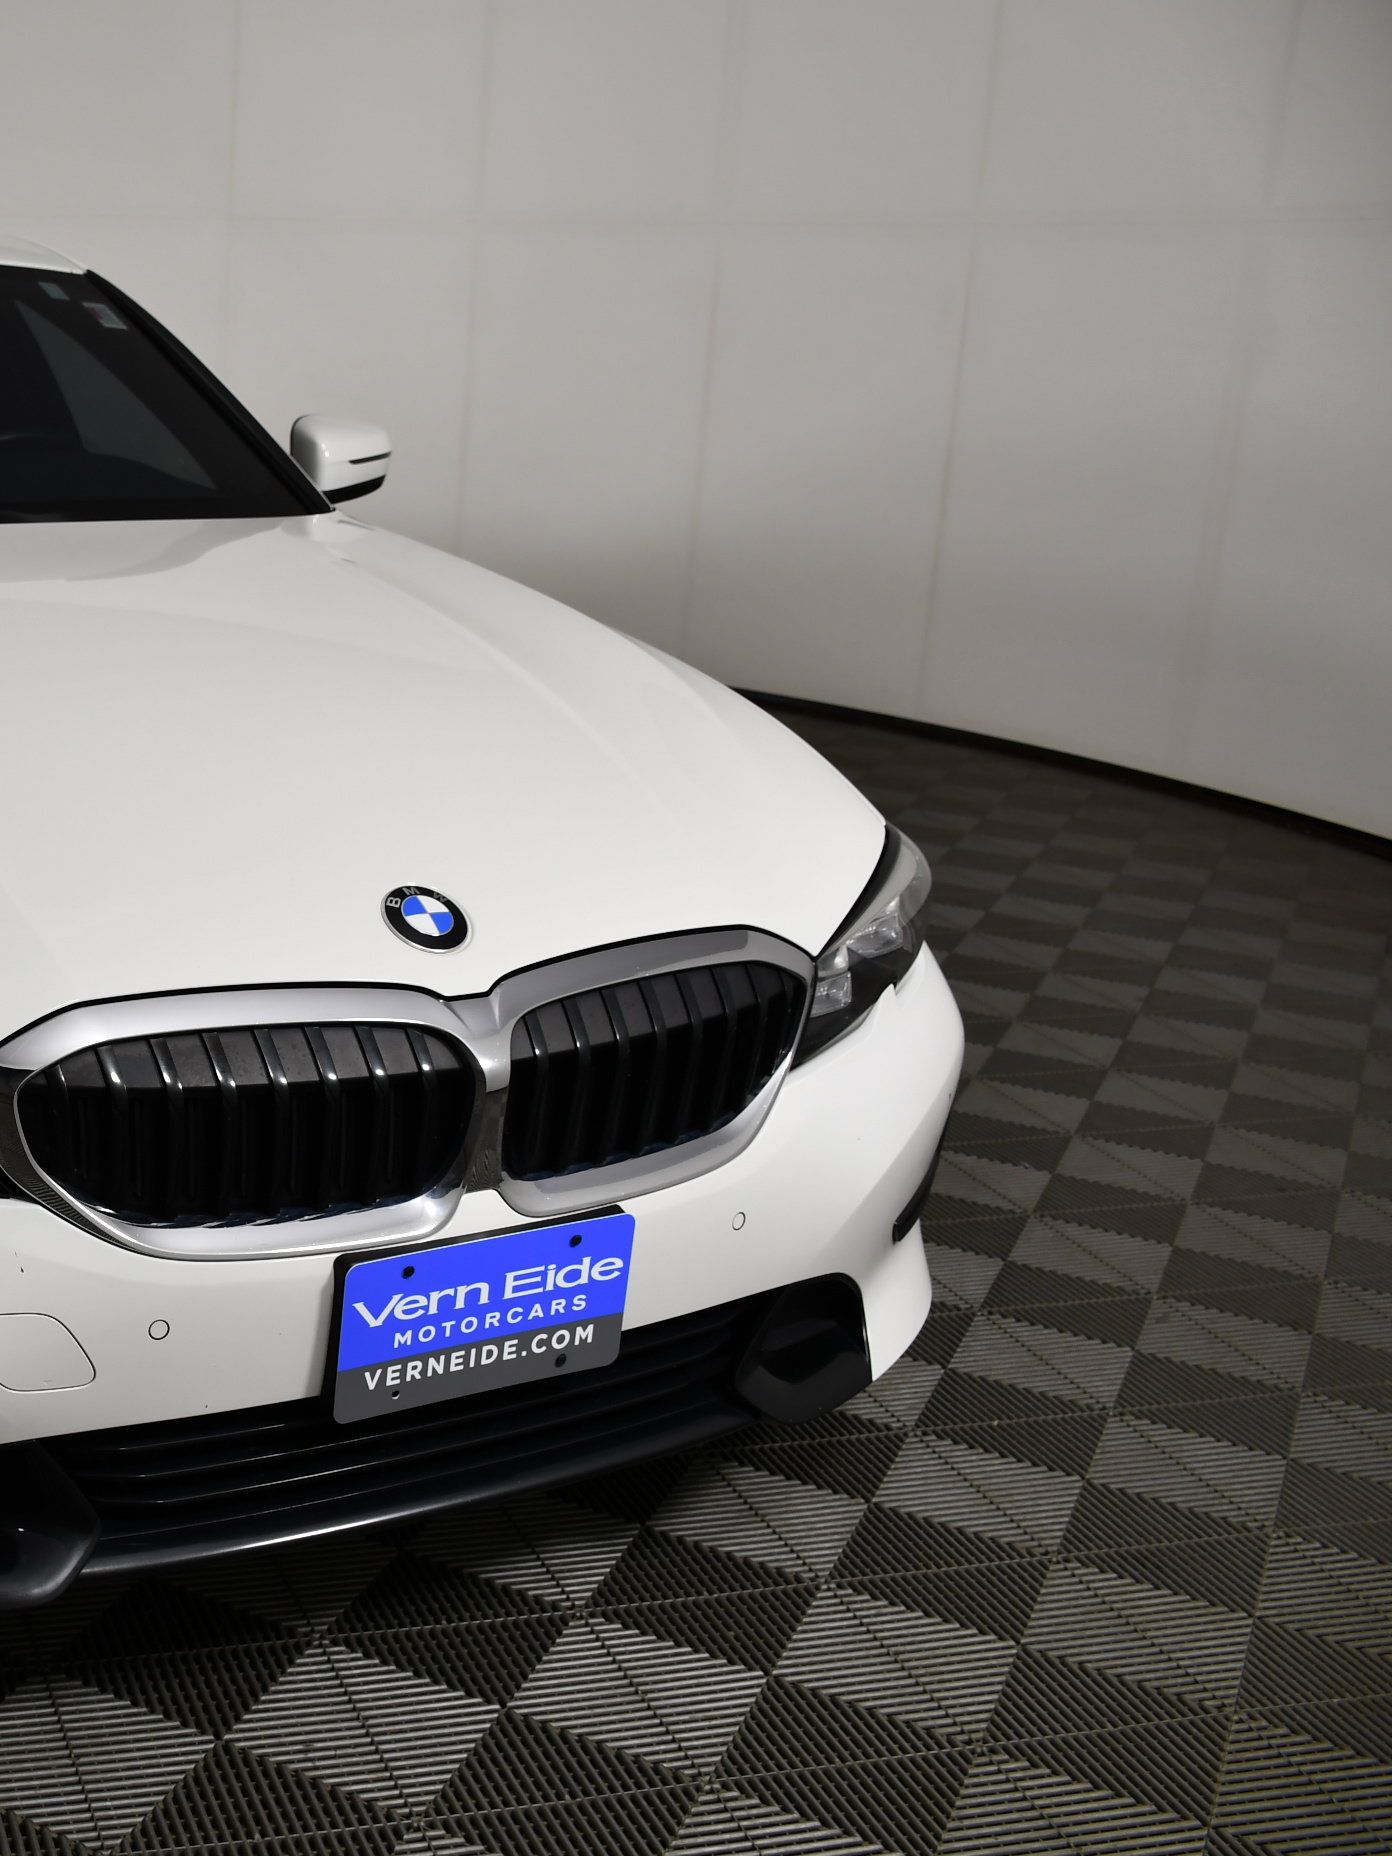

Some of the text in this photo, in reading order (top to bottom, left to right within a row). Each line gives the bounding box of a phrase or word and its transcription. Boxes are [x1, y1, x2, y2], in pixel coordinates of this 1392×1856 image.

[352, 1256, 624, 1328] Vern Eide
[393, 1294, 587, 1348] MOTORCARS
[364, 1323, 595, 1391] VERNEIDE.COM
